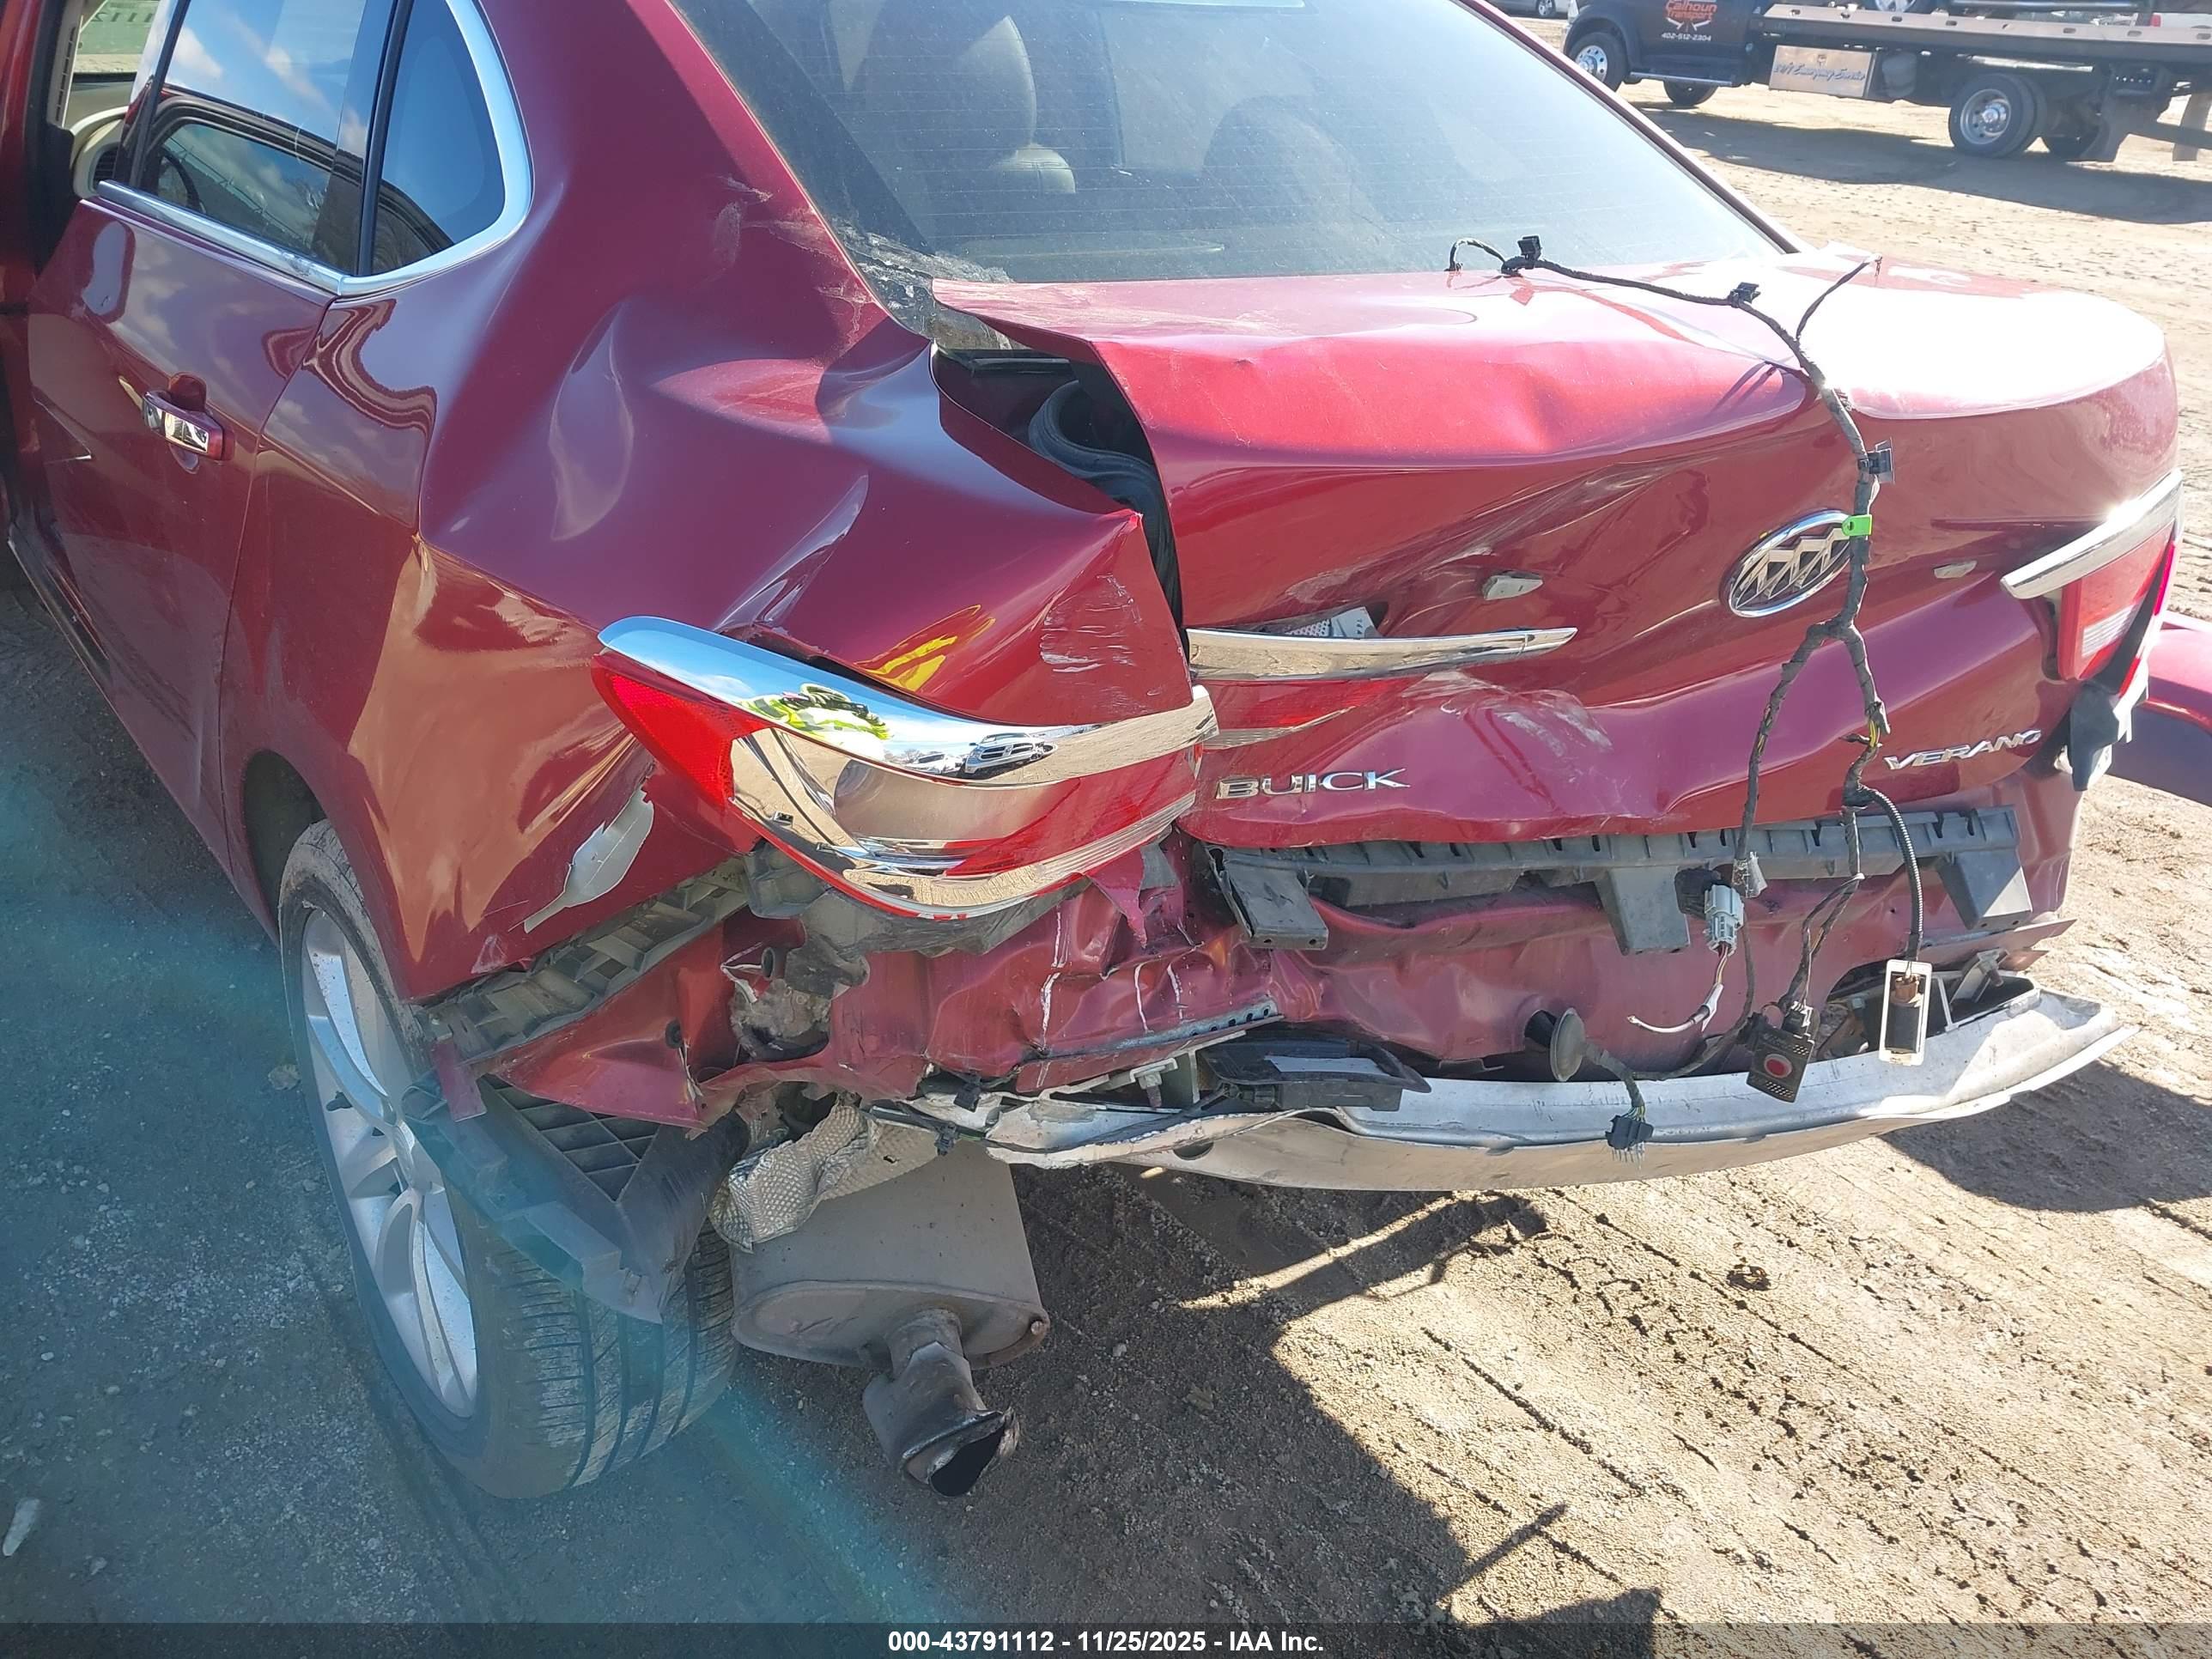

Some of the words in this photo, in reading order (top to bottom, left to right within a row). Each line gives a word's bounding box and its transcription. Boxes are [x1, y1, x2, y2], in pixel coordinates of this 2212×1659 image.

[1666, 0, 1717, 12] Calhoun
[1668, 9, 1714, 21] Transport
[1662, 32, 1712, 41] 402-512-2304
[1883, 729, 2041, 770] VERANO
[1215, 769, 1411, 799] BUICK
